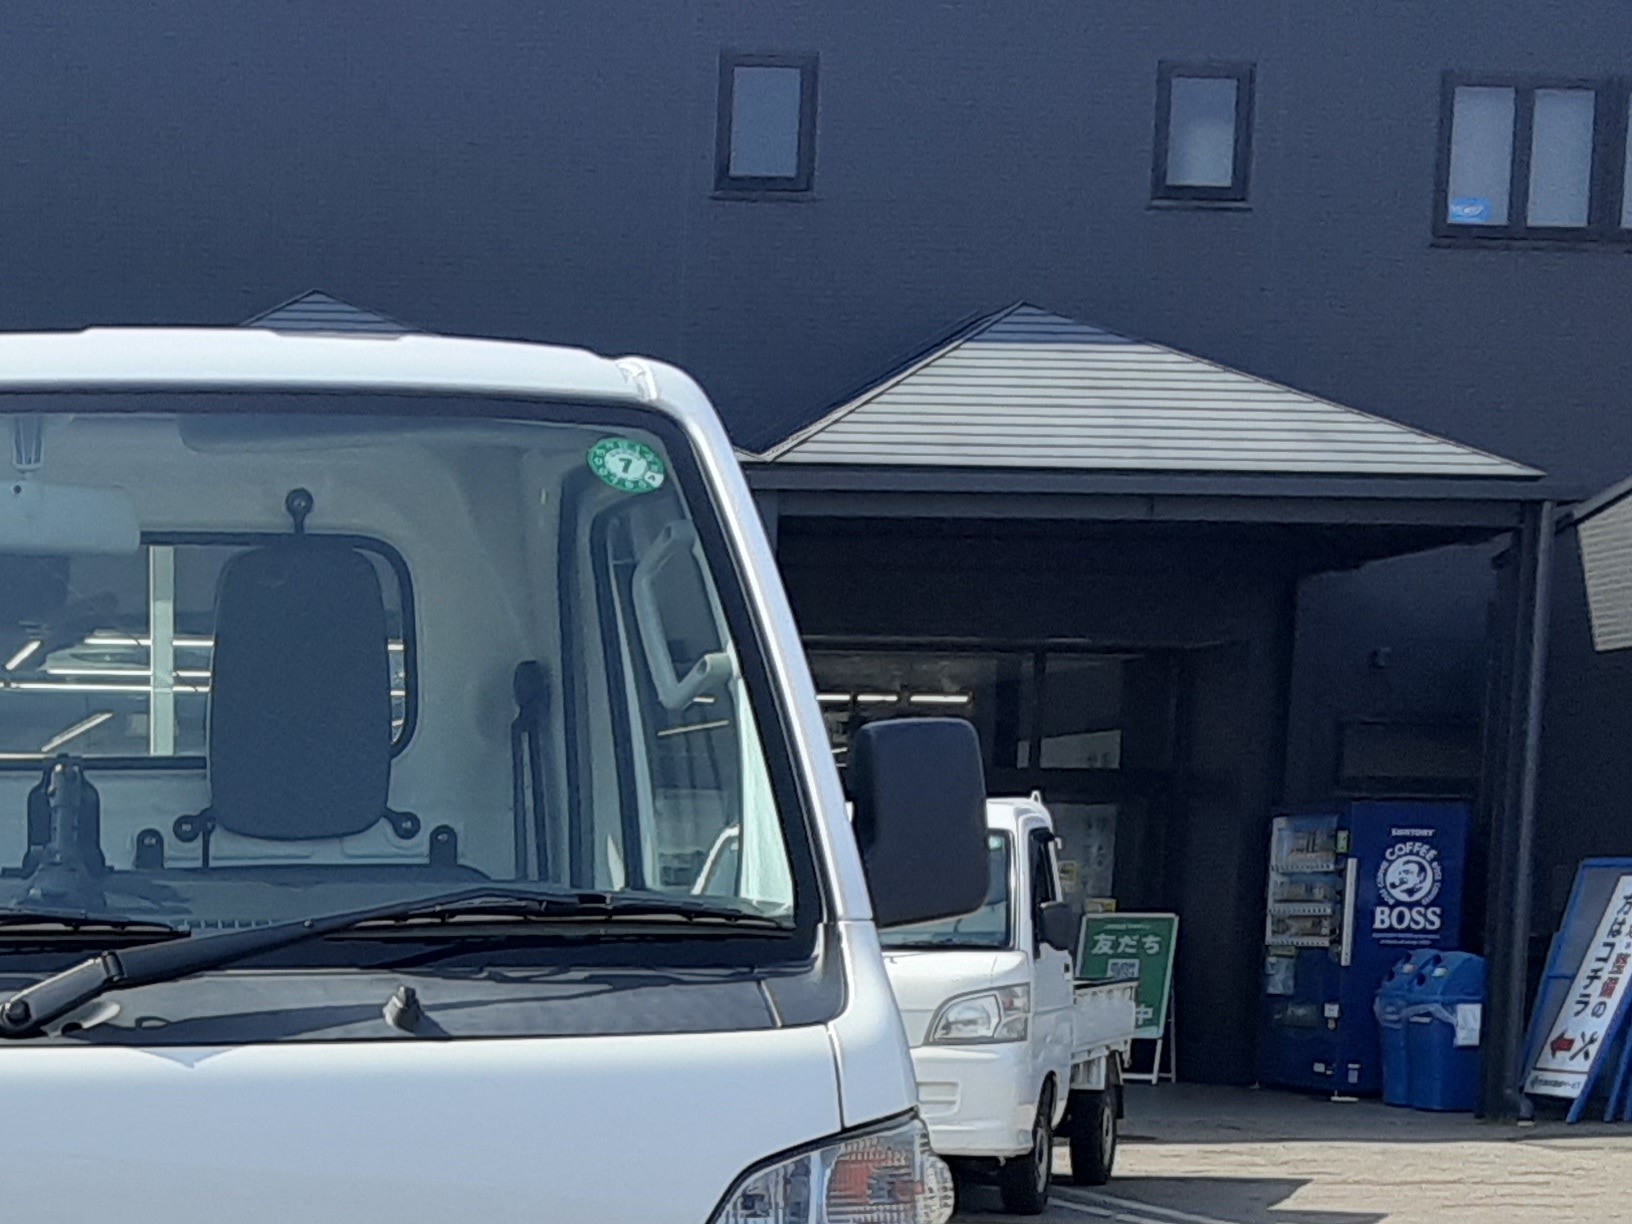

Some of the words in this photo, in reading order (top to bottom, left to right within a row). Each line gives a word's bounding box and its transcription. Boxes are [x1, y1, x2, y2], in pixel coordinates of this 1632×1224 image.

[618, 457, 632, 474] 7
[1385, 841, 1438, 861] COFFEE
[1372, 906, 1442, 930] BOSS
[1091, 933, 1162, 955] 友だち
